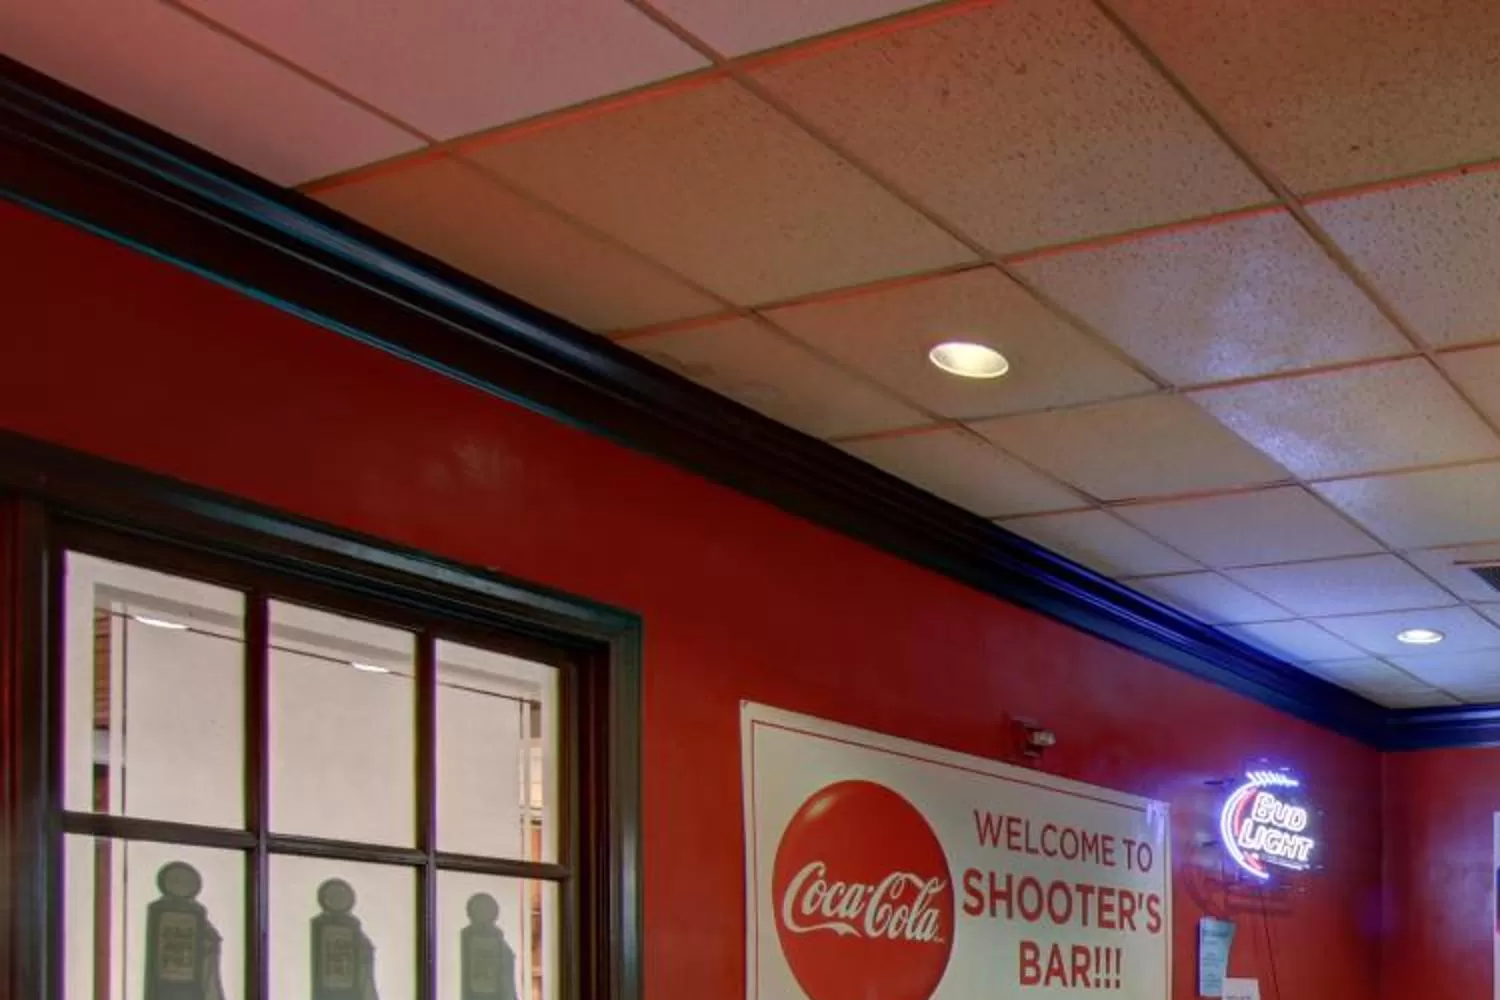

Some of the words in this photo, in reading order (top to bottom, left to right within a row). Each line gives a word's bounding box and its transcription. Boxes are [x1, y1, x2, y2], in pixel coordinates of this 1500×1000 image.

[1252, 790, 1307, 831] BUD
[974, 809, 1115, 867] WELCOME
[1122, 840, 1154, 873] TO
[1238, 818, 1315, 862] LIGHT
[961, 867, 1162, 934] SHOOTER'S
[1018, 941, 1122, 989] BAR!!!
